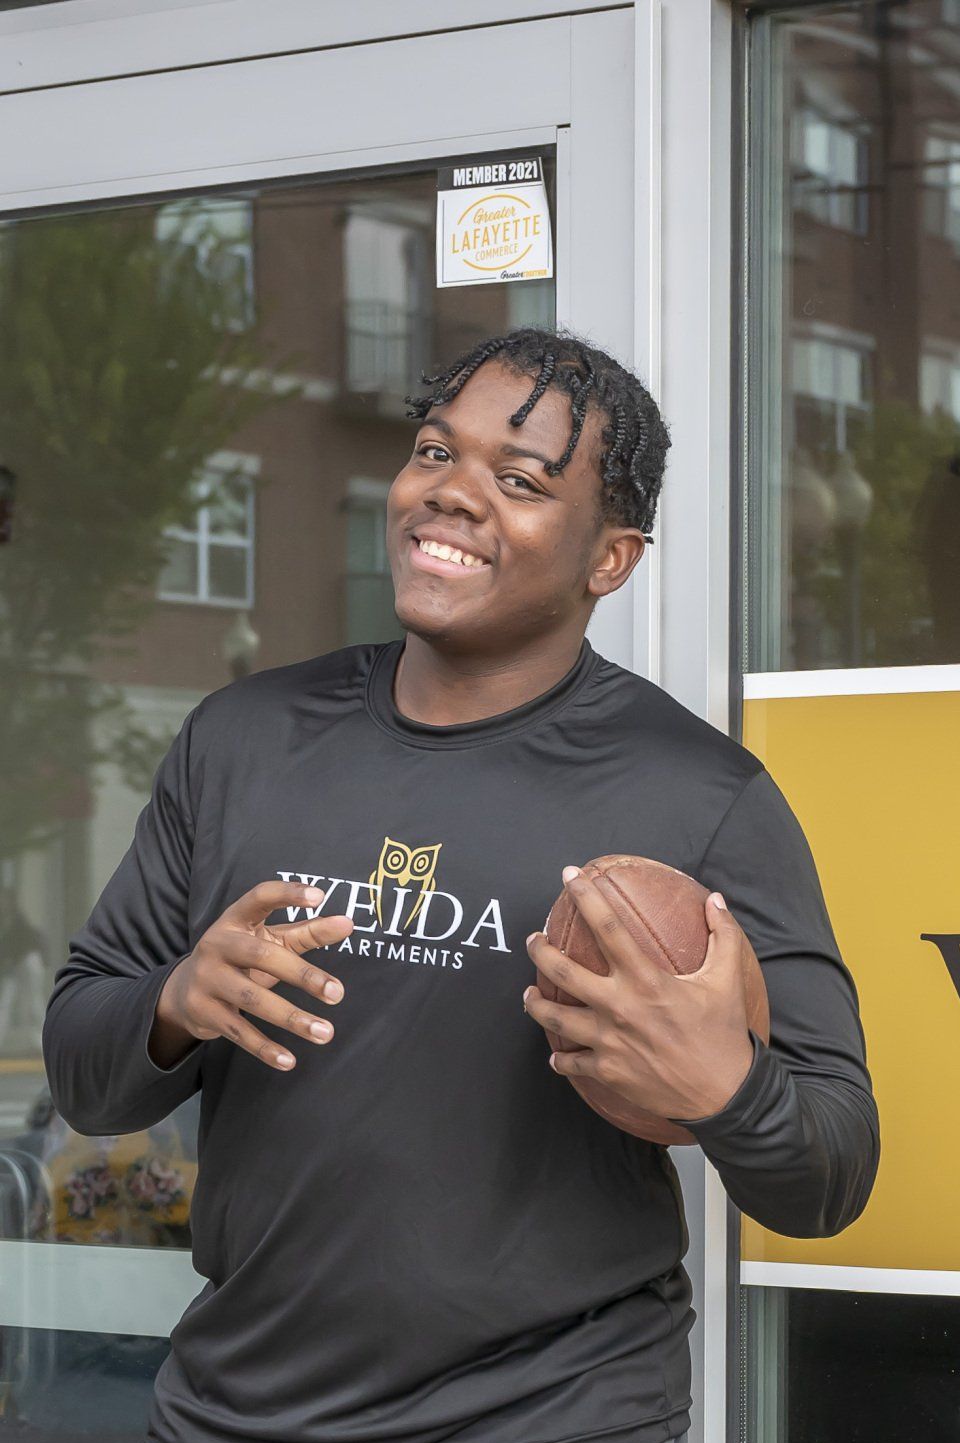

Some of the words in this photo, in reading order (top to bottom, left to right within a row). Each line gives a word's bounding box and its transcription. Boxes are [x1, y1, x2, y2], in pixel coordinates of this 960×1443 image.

[453, 163, 507, 187] MEMBER
[508, 160, 538, 182] 2021
[473, 206, 516, 225] Greater
[451, 214, 541, 255] LAFAYETTE
[475, 243, 519, 262] COMMERCE
[316, 936, 464, 970] ARTMENTS
